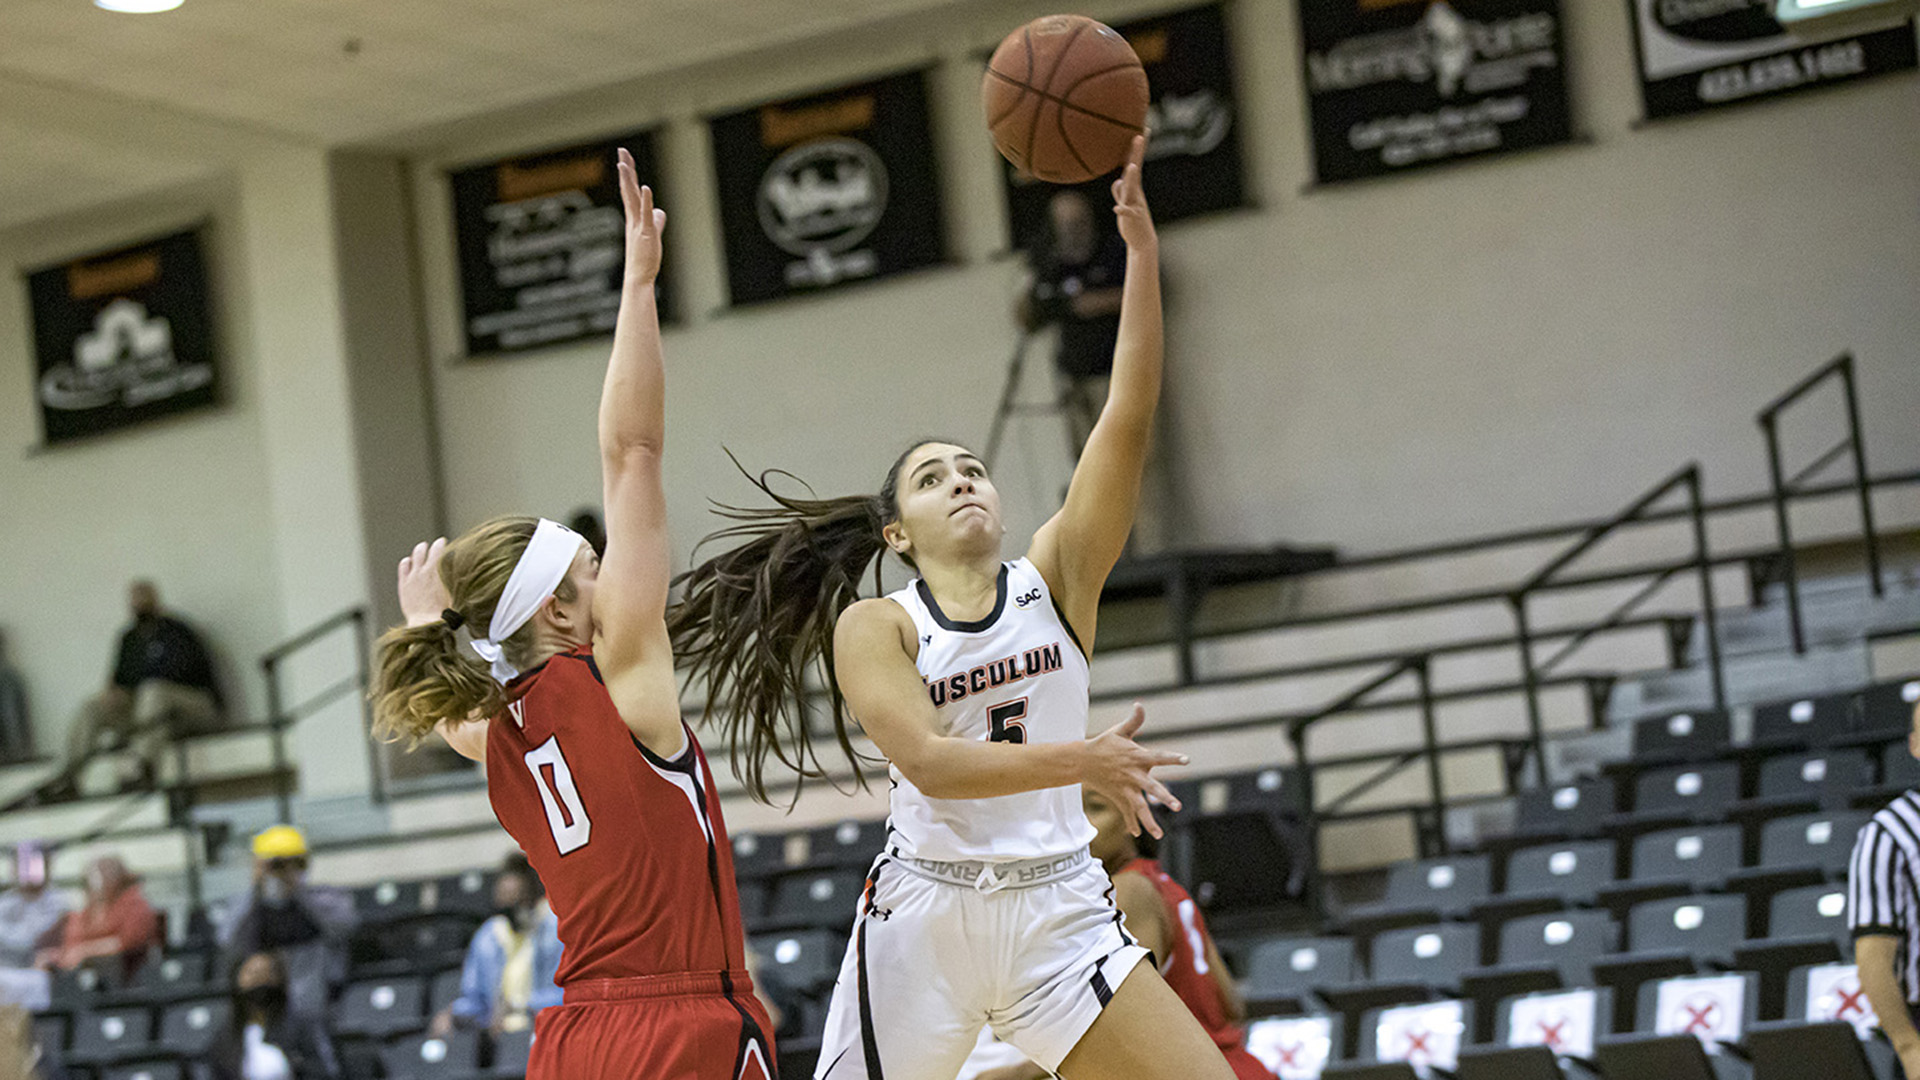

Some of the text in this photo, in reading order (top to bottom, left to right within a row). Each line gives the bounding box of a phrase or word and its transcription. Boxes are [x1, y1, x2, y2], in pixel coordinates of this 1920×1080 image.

[1015, 587, 1042, 607] SAC
[921, 642, 1063, 709] USCULUM
[986, 696, 1028, 744] 5
[523, 732, 593, 858] 0
